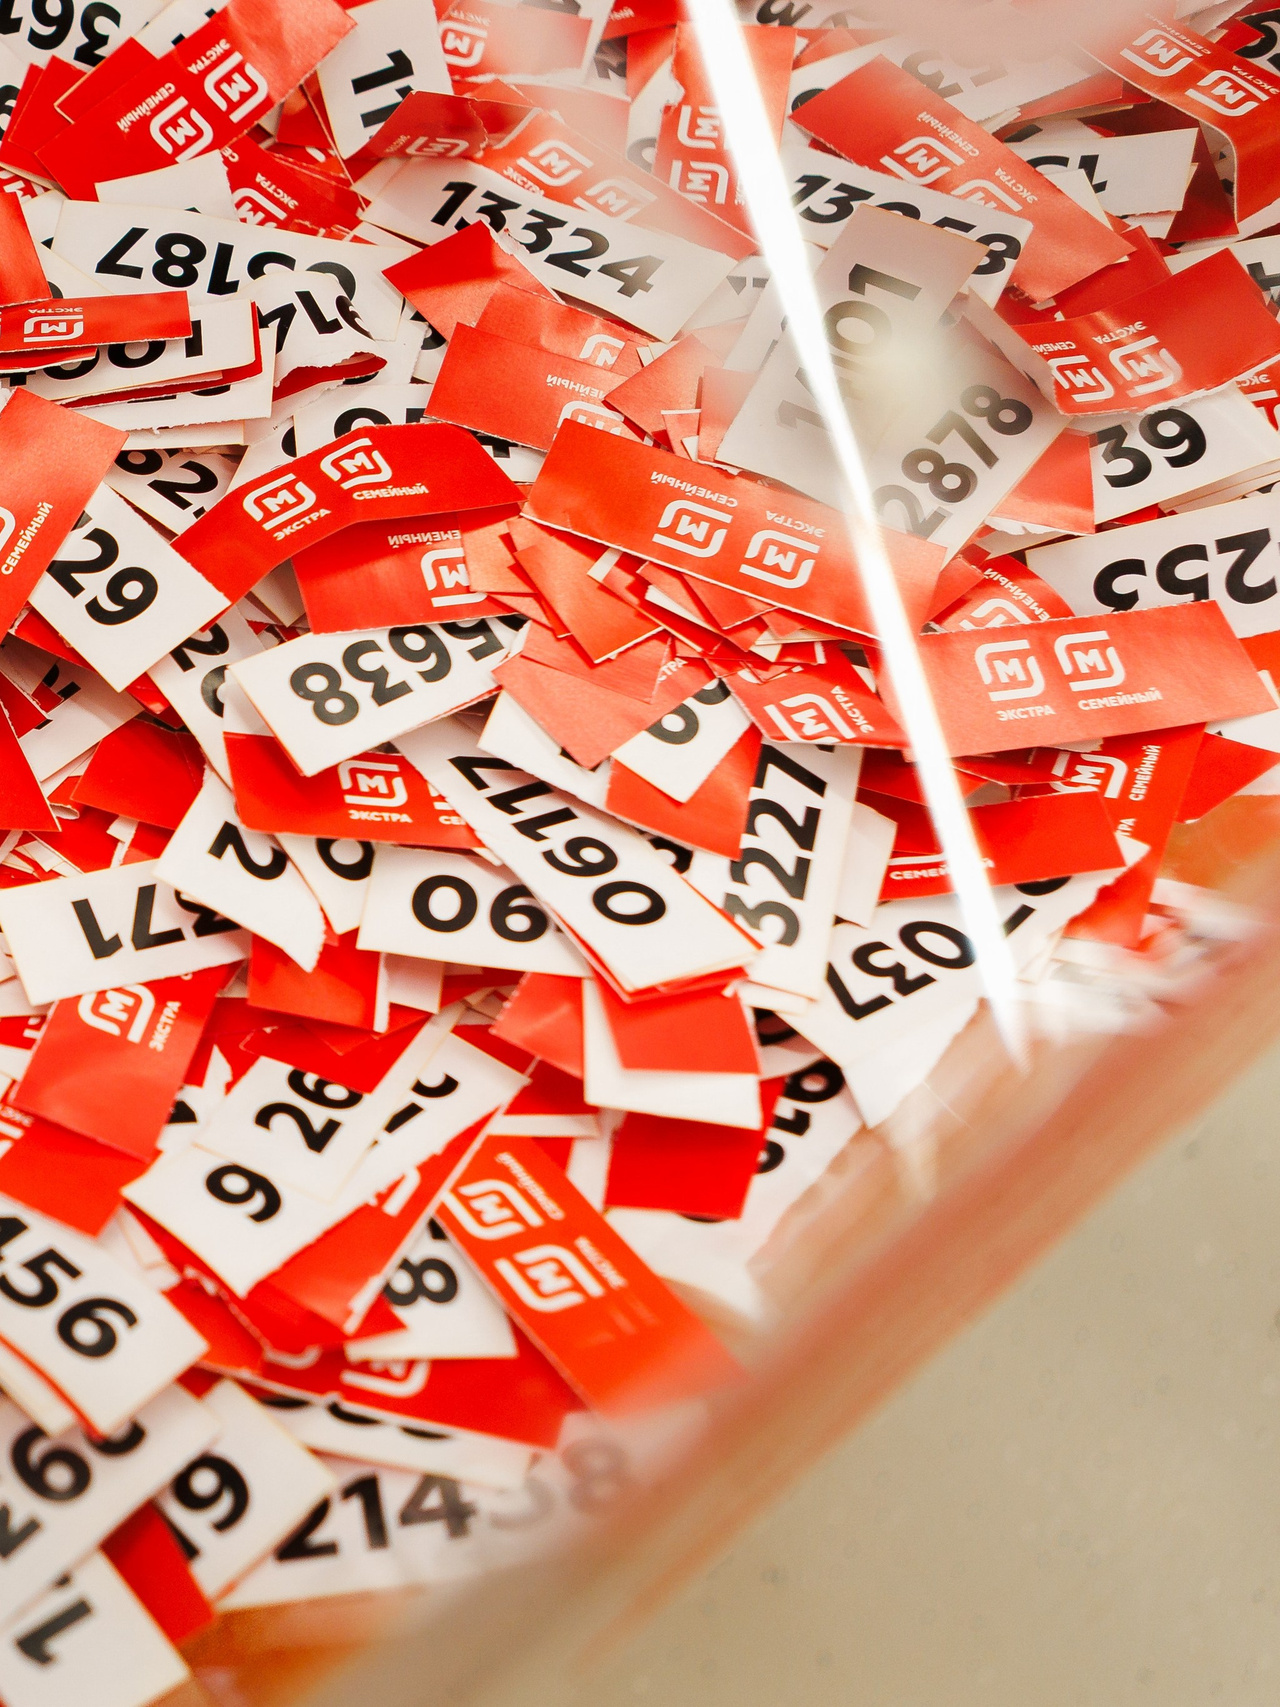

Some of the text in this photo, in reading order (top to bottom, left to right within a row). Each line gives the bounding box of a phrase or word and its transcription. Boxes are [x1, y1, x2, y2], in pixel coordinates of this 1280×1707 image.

[187, 38, 231, 74] ЭКСТРА
[1231, 65, 1280, 95] ЭКСТРА
[117, 82, 176, 133] СЕМЕЙНЫЙ
[916, 111, 979, 156] СЕМЕЙНЫЙ
[255, 172, 299, 209] ЭКСТРА
[993, 167, 1037, 203] ЭКСТРА
[431, 182, 664, 298] 13324
[1092, 321, 1147, 344] ЭКСТРА
[876, 385, 1032, 541] 2878
[1090, 408, 1206, 488] 39
[353, 483, 429, 501] СЕМЕЙНЫЙ
[651, 471, 738, 507] СЕМЕЙНЫЙ
[1, 502, 53, 575] СЕМЕЙНЫЙ
[273, 508, 331, 541] ЭКСТРА
[765, 510, 826, 538] ЭКСТРА
[290, 615, 530, 726] 5638
[830, 685, 874, 733] ЭКСТРА
[997, 705, 1056, 721] ЭКСТРА
[1078, 688, 1163, 711] СЕМЕЙНЫЙ
[1129, 745, 1160, 801] СЕМЕЙНЫЙ
[349, 810, 413, 823] ЭКСТРА
[724, 743, 835, 947] 3227
[149, 1001, 180, 1051] ЭКСТРА
